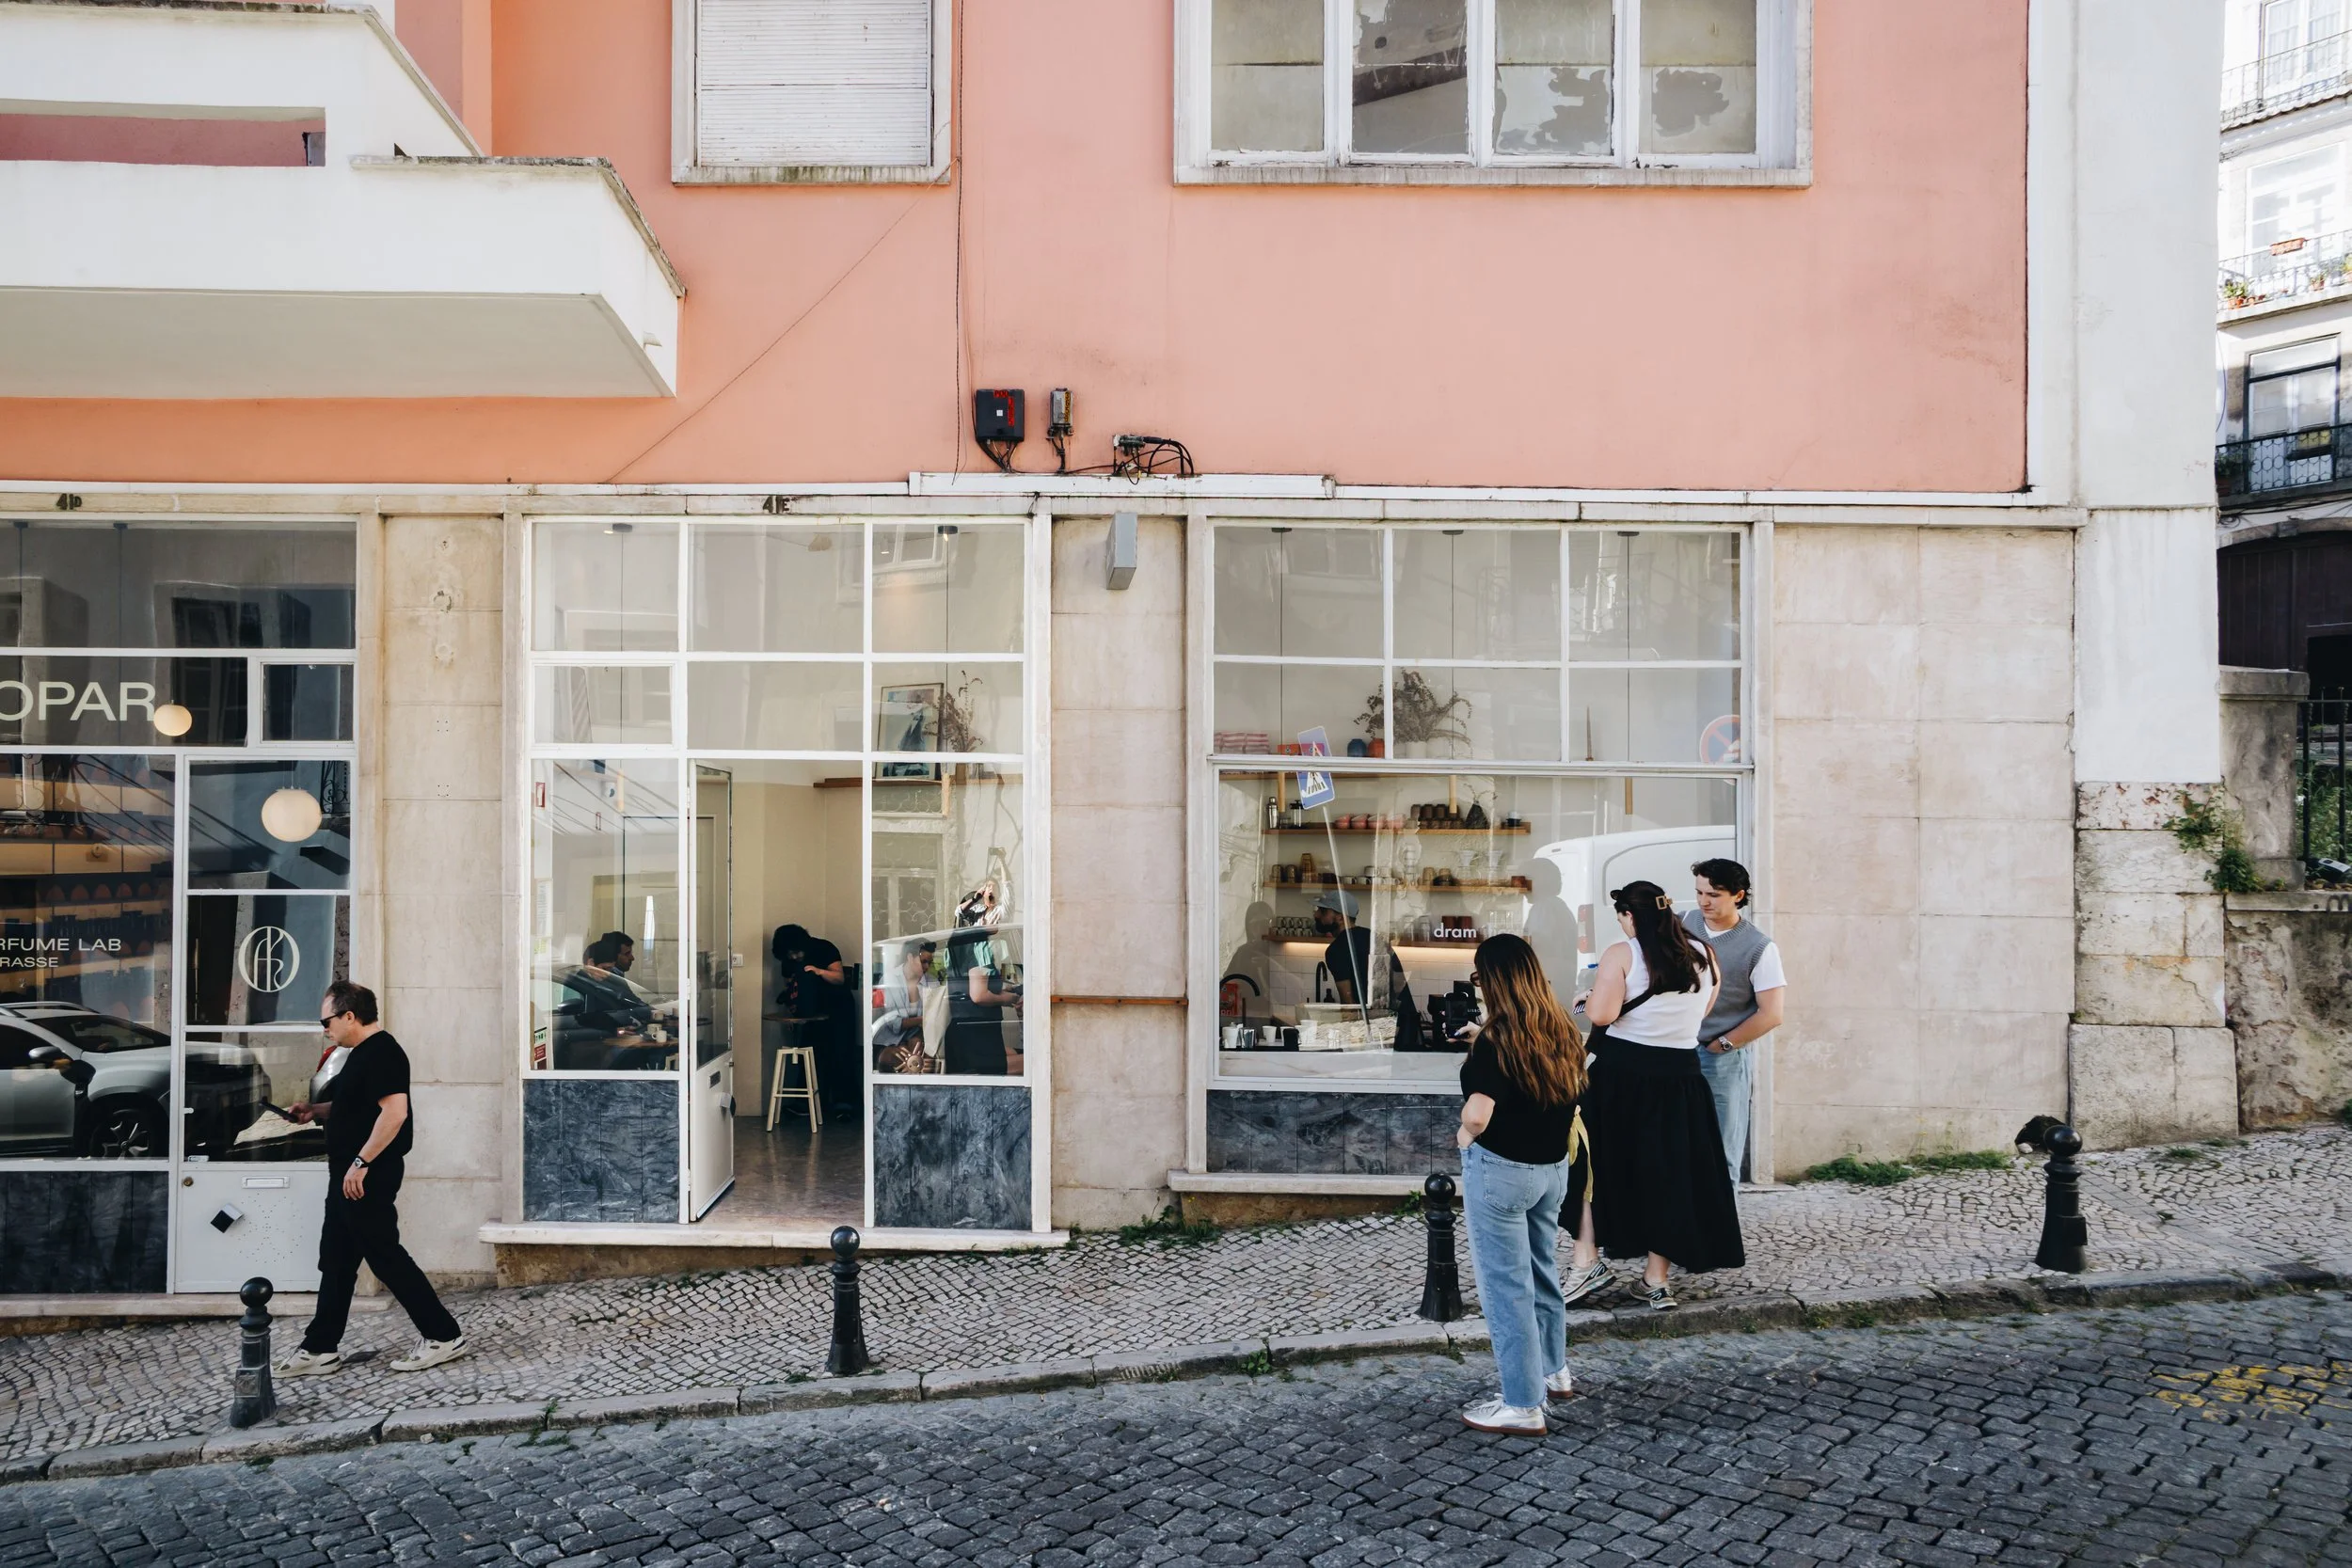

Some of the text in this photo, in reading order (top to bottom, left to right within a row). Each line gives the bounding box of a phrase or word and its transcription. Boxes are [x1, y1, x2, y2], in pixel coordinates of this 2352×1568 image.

[0, 680, 156, 721] OPAR
[1434, 923, 1477, 938] dram
[78, 938, 121, 951] LAB
[0, 957, 58, 968] RASSE
